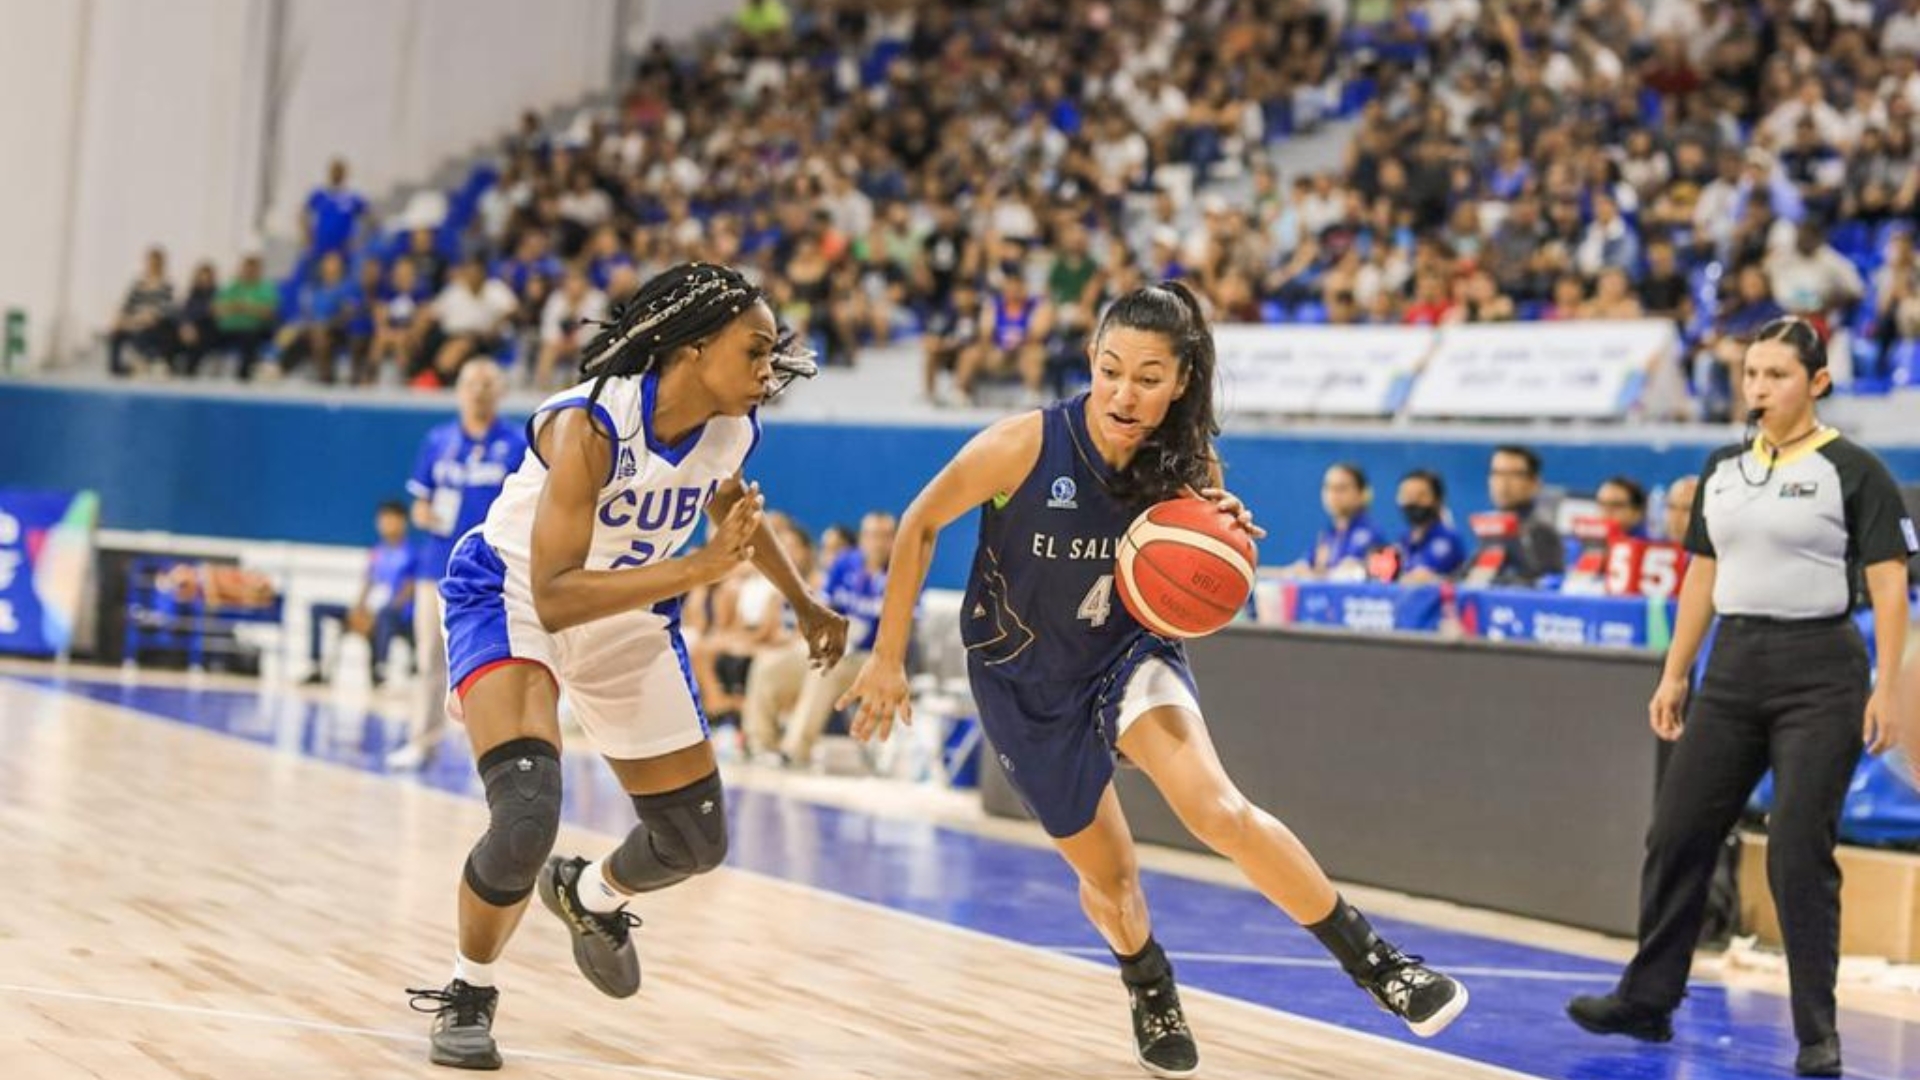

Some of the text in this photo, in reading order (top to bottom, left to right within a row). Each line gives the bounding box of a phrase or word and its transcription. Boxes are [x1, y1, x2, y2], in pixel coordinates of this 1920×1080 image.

[1032, 532, 1057, 559] EL
[1640, 546, 1677, 597] 5
[1076, 575, 1114, 628] 4
